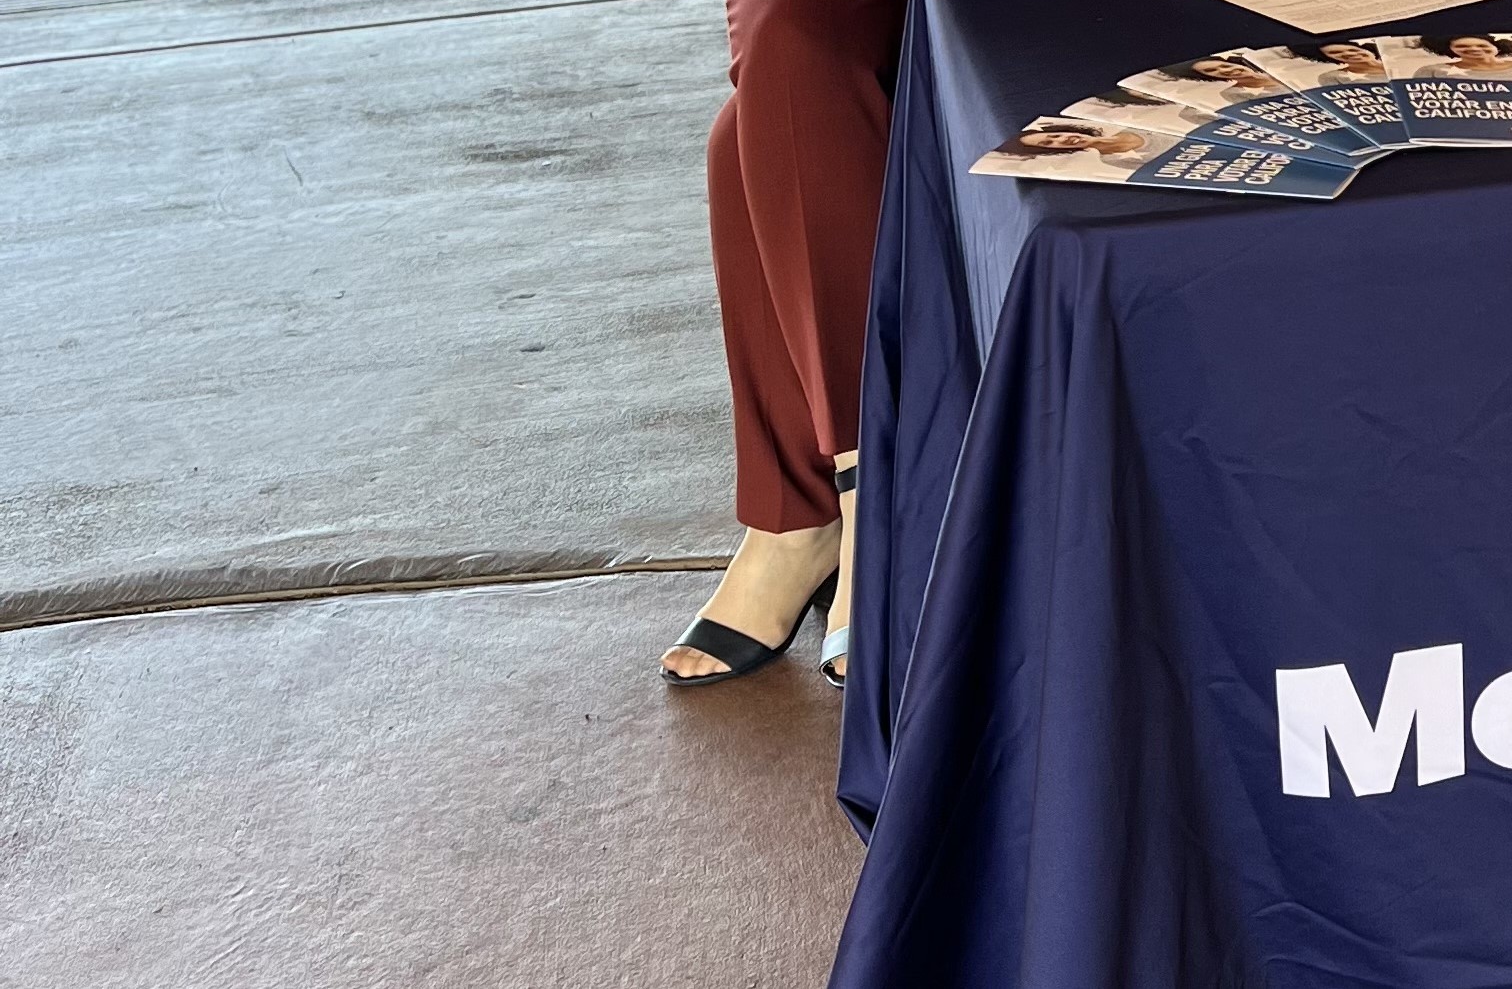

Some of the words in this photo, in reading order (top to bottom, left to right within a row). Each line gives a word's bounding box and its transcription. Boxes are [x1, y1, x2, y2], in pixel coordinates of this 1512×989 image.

[1322, 87, 1371, 101] UNA
[1405, 83, 1452, 93] UNA
[1457, 81, 1511, 93] GUÍA
[1333, 95, 1394, 109] PARA
[1408, 91, 1467, 101] PARA
[1240, 100, 1289, 116] UNA
[1344, 102, 1399, 116] VOTA
[1409, 99, 1481, 110] VOTAR
